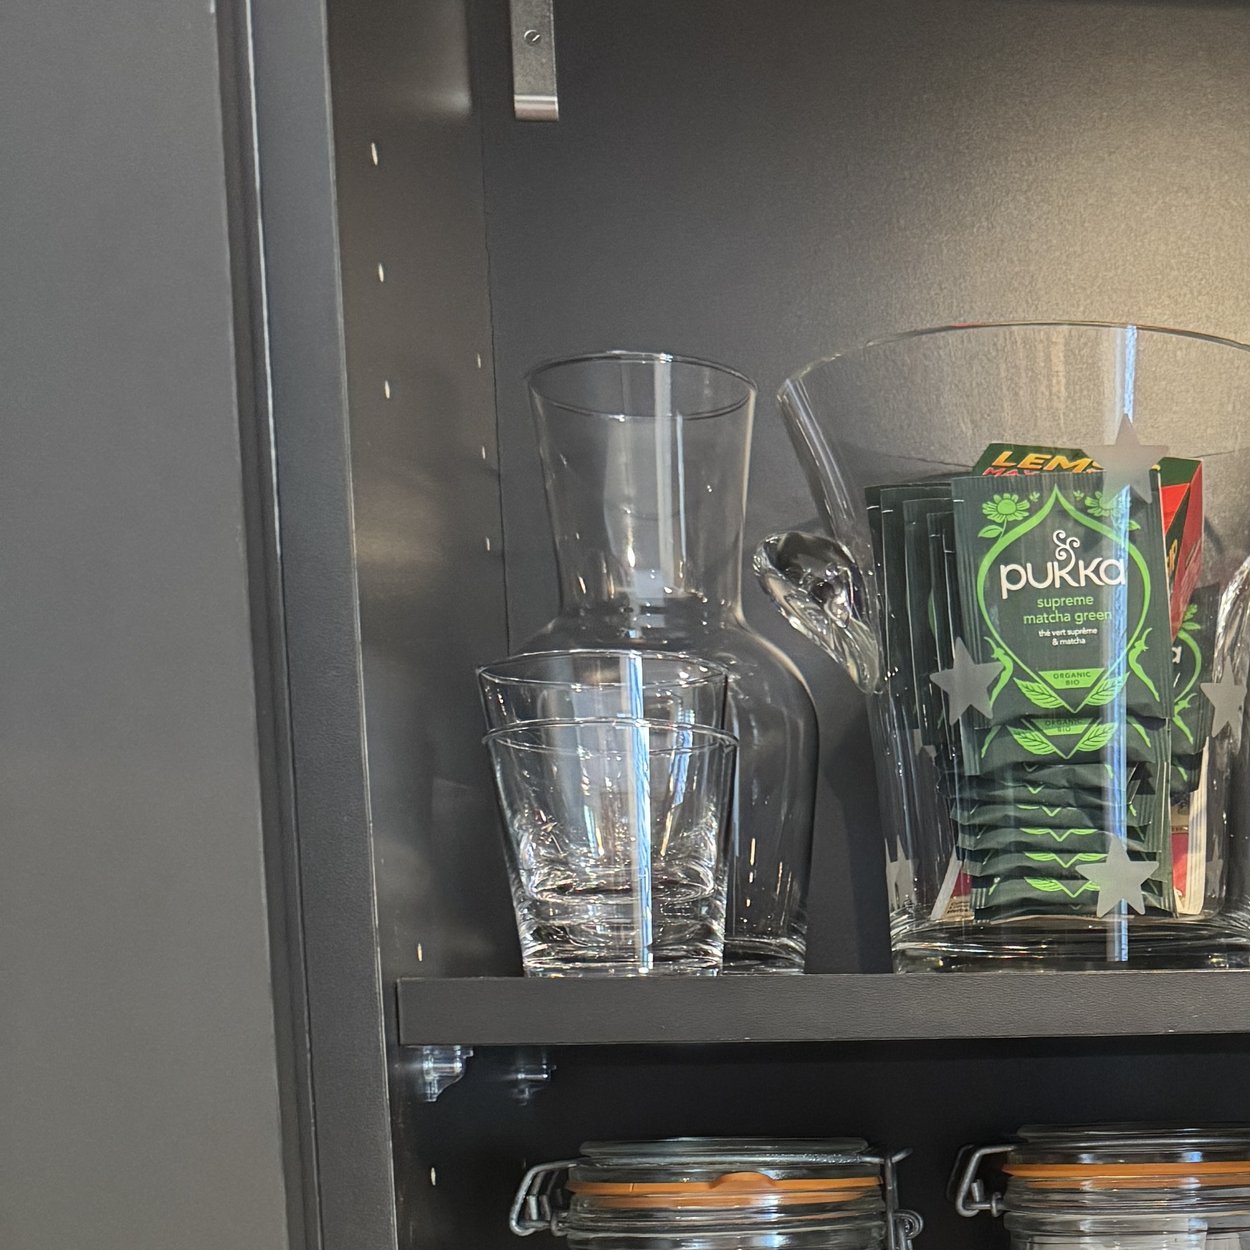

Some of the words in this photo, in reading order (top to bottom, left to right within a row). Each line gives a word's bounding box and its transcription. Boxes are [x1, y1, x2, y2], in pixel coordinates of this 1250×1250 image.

[992, 451, 1104, 473] LEM
[1000, 530, 1127, 599] pukka
[1037, 596, 1094, 610] supreme
[1023, 610, 1071, 624] matcha
[1074, 611, 1112, 625] green
[1052, 638, 1058, 646] &
[1060, 637, 1086, 645] matcha
[1052, 671, 1092, 680] ORGANIC
